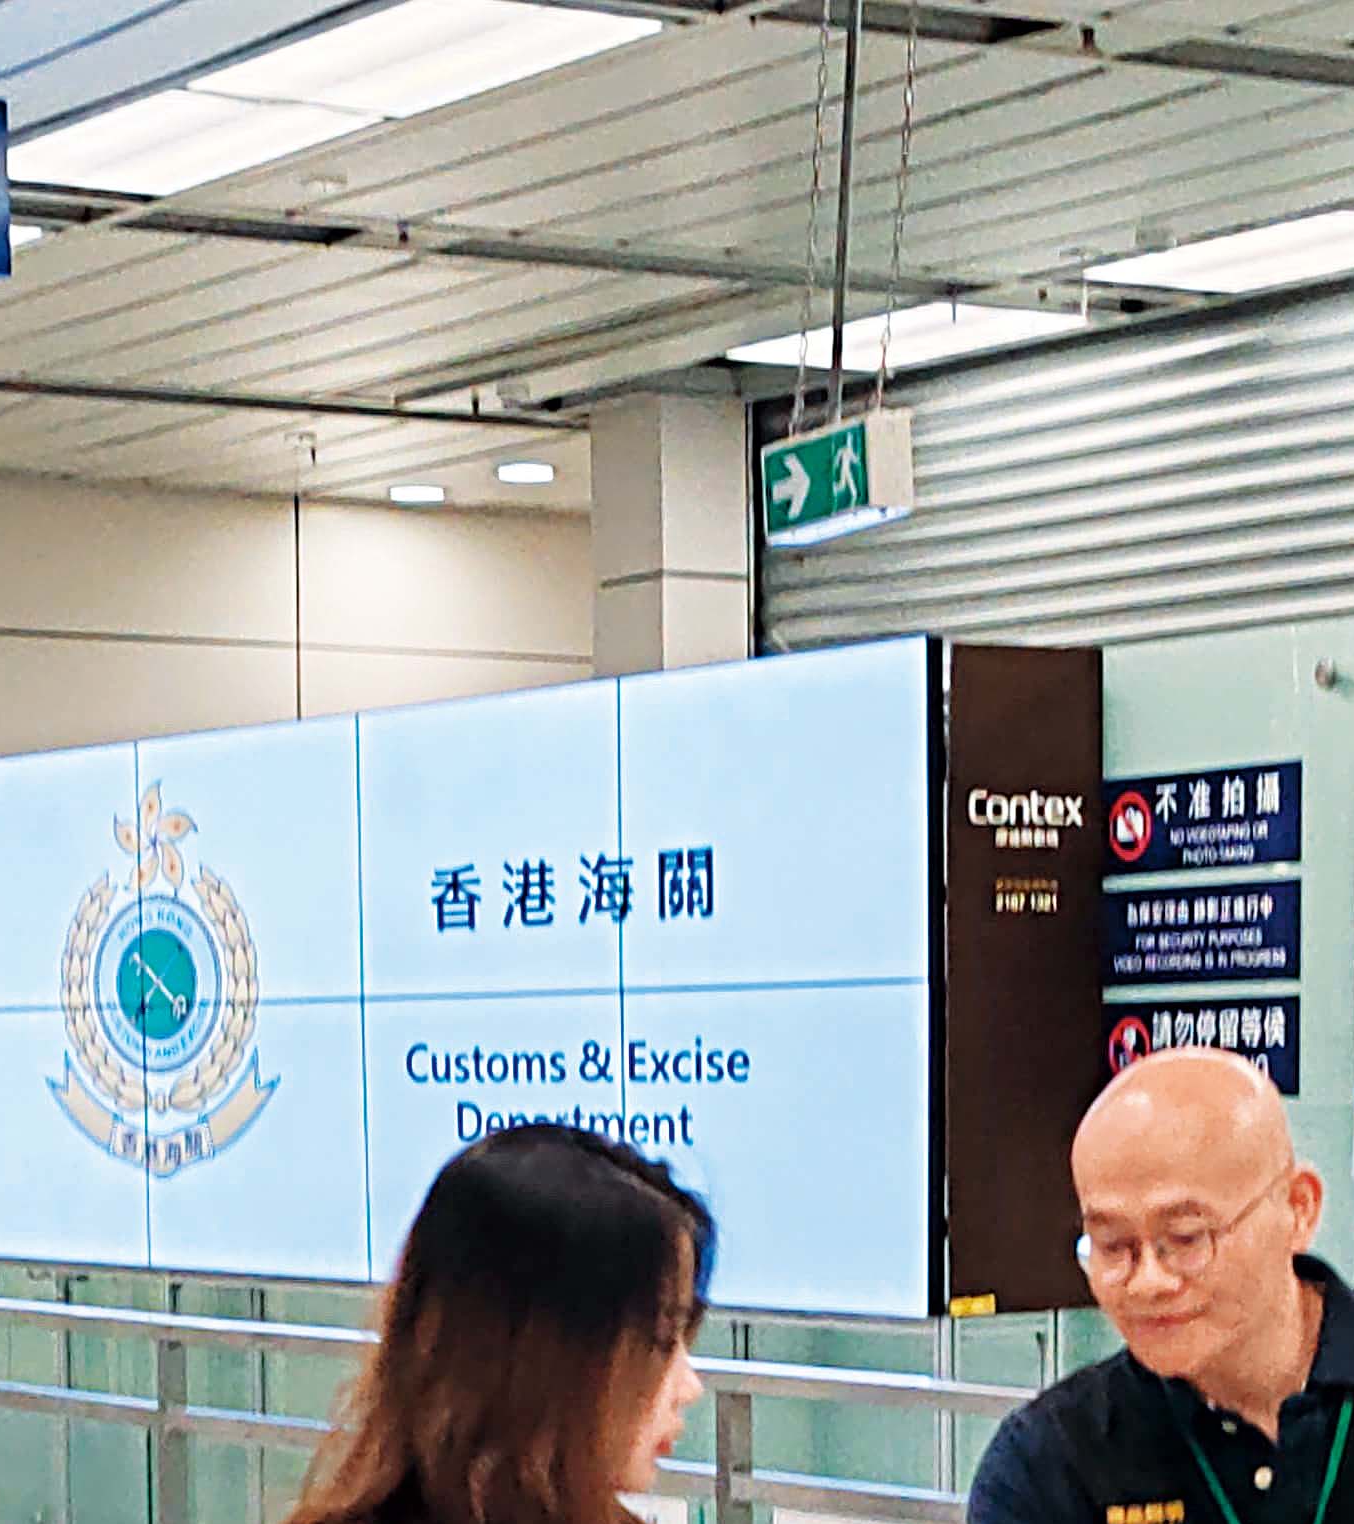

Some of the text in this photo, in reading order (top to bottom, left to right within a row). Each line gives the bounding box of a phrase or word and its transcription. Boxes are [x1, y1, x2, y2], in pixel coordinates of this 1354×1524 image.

[968, 787, 1083, 827] Contex
[431, 846, 714, 933] 香港海關
[406, 1035, 750, 1083] Customs & Excise
